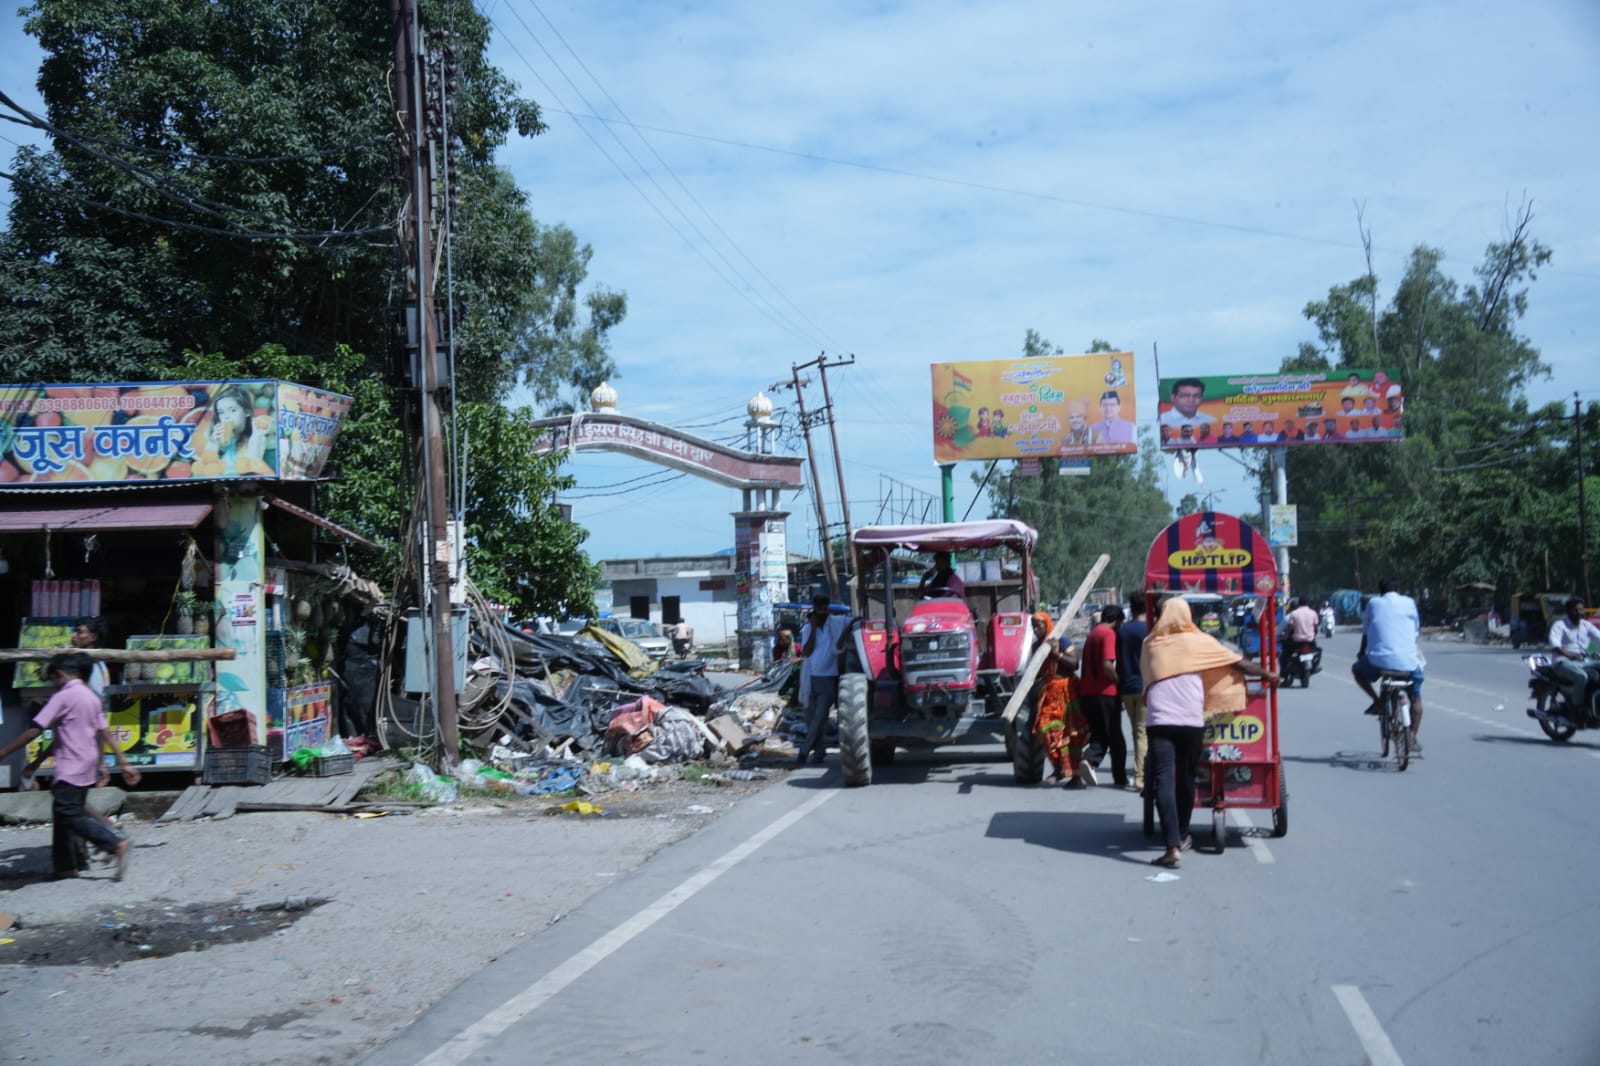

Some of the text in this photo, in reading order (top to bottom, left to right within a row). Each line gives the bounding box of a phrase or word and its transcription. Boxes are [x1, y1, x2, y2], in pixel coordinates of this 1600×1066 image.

[13, 425, 86, 471] जूस
[1182, 552, 1246, 566] HOTLIP
[1204, 721, 1258, 739] OTLIP
